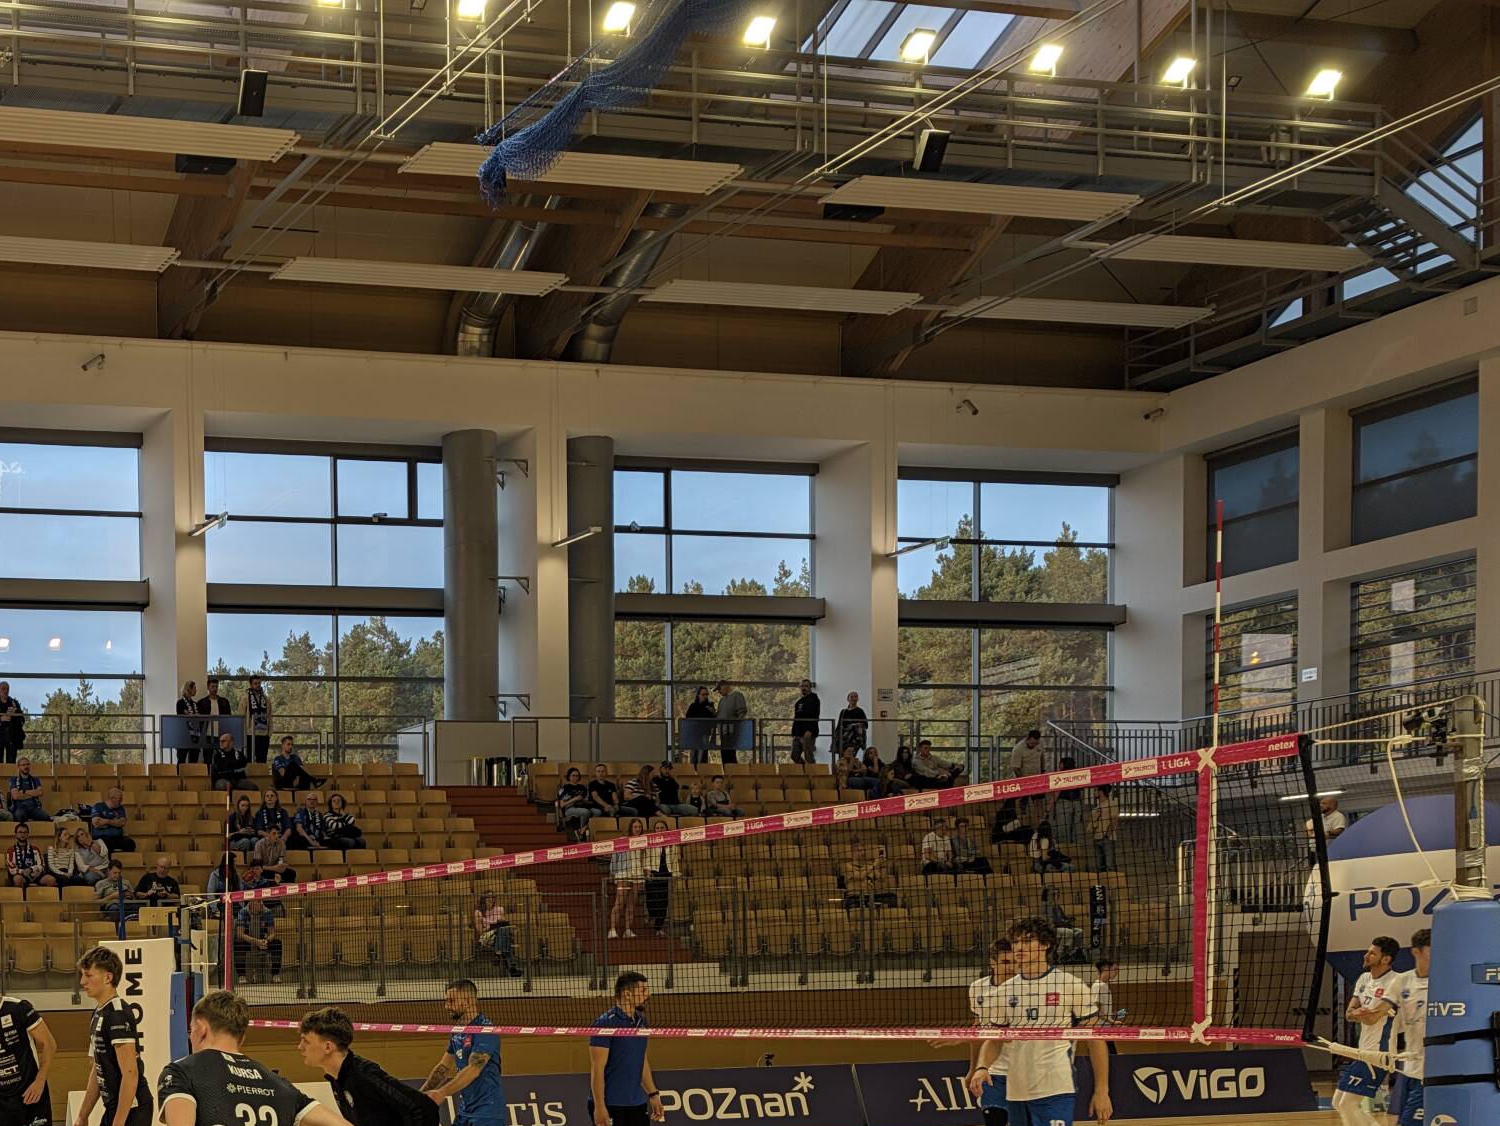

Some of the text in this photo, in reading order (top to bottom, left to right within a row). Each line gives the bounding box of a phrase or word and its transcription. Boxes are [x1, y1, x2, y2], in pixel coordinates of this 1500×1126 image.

[1267, 740, 1296, 752] netex
[1168, 757, 1191, 769] LIGA
[1002, 783, 1021, 793] LIGA
[227, 1063, 263, 1081] KURSA
[236, 1085, 276, 1097] PIERROT
